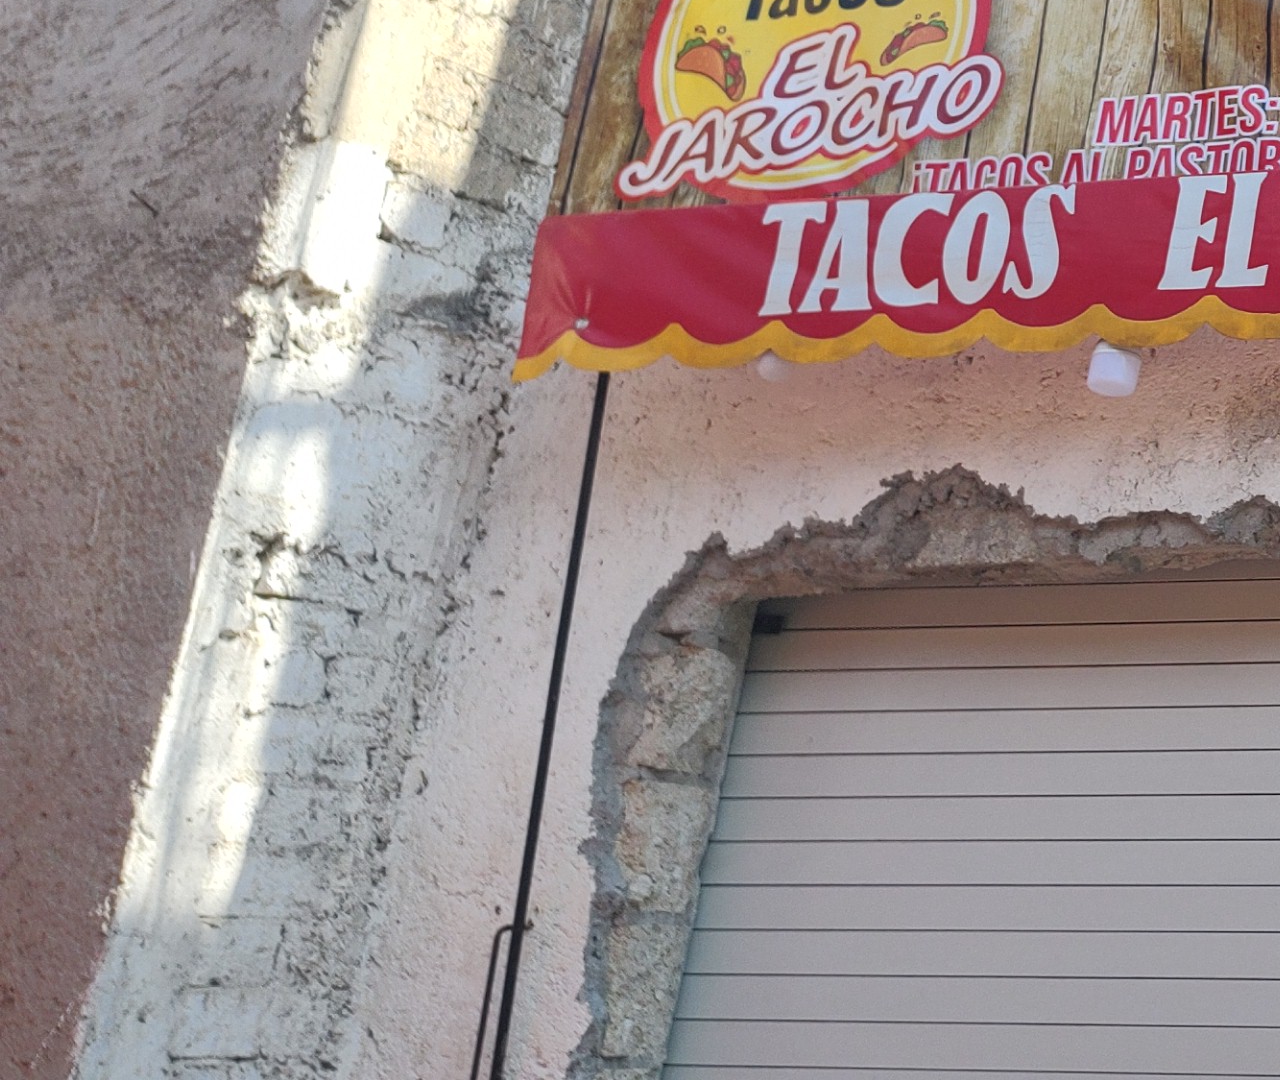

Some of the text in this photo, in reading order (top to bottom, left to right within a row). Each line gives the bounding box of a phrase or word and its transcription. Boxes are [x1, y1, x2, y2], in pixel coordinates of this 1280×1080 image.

[775, 28, 859, 100] EL
[624, 59, 996, 193] JAROCHO
[1098, 86, 1280, 146] MARTES:
[759, 184, 1077, 316] TACOS
[1157, 173, 1270, 290] EL
